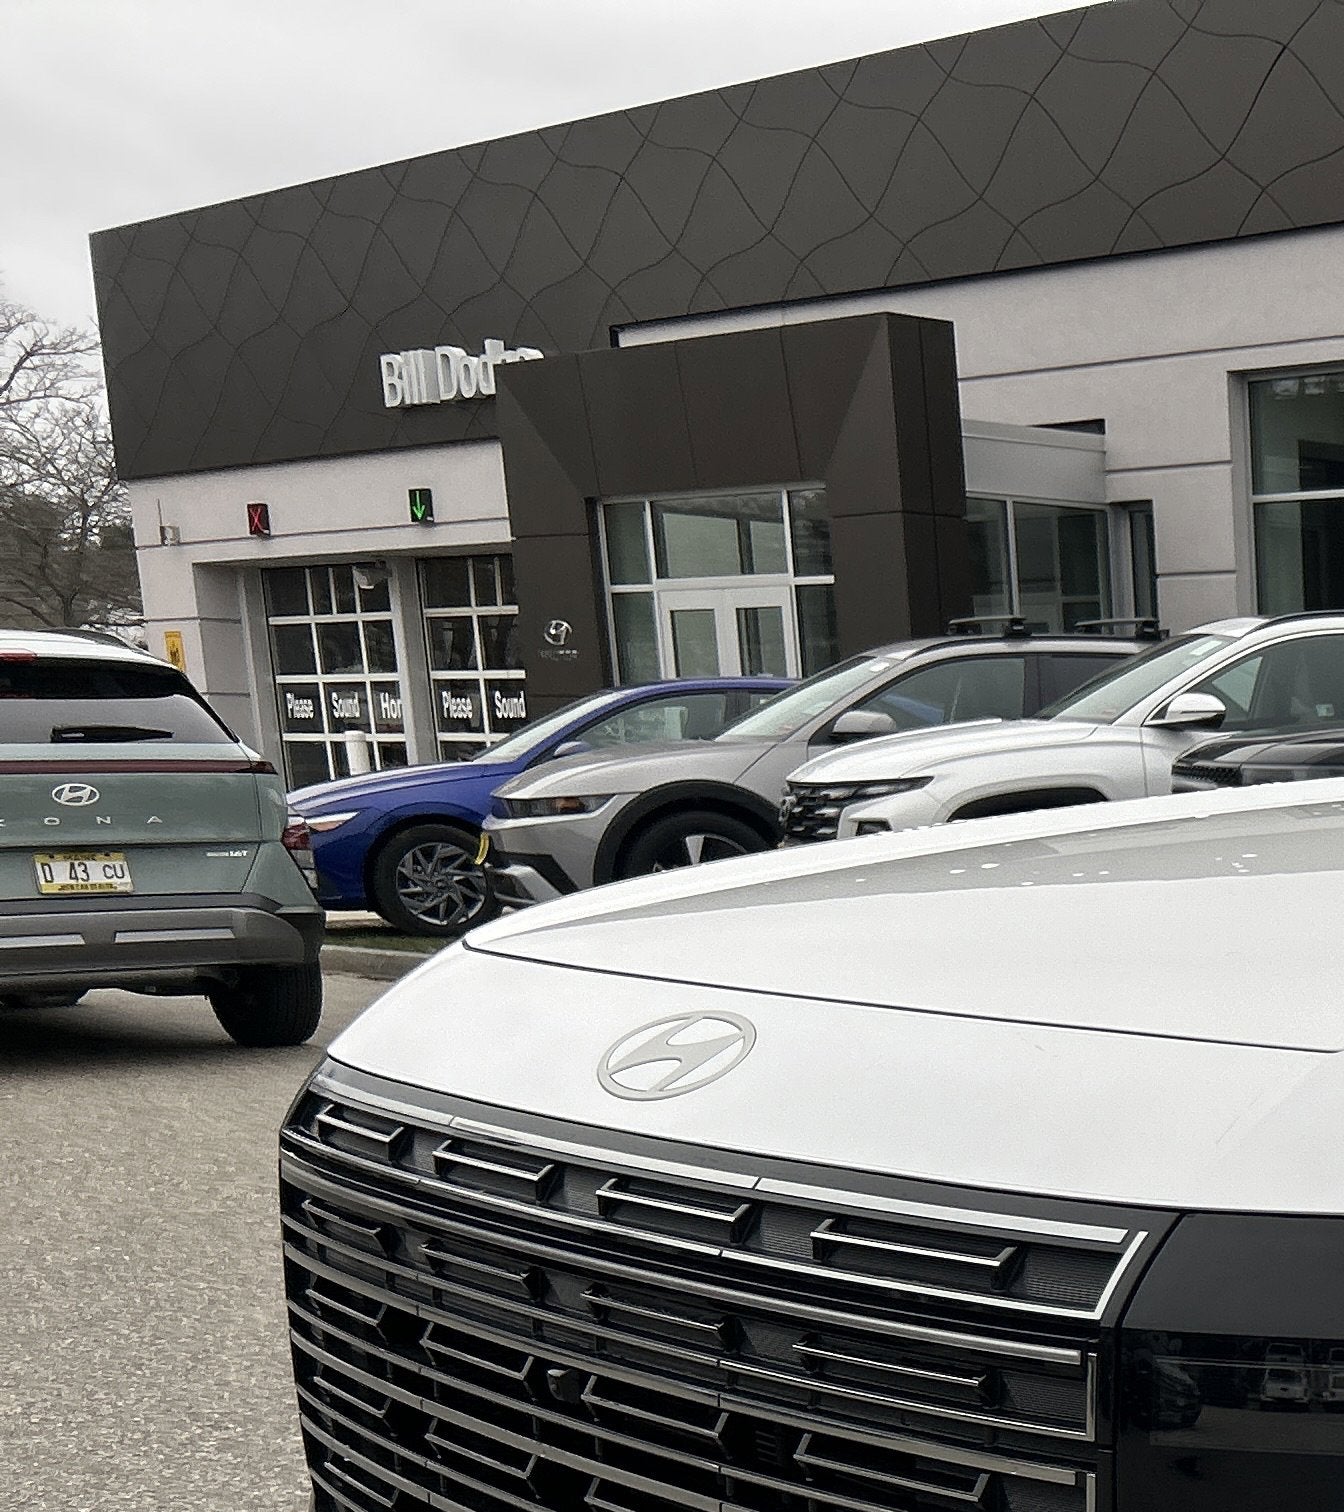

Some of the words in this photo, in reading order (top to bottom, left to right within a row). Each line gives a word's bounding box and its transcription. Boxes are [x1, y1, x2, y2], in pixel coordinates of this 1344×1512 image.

[380, 350, 440, 408] Bill
[435, 338, 544, 401] Dod
[286, 692, 314, 719] Please
[331, 692, 360, 718] Sound
[442, 691, 473, 719] Please
[495, 690, 526, 719] Sound
[69, 861, 90, 882] 43
[102, 864, 125, 880] CU
